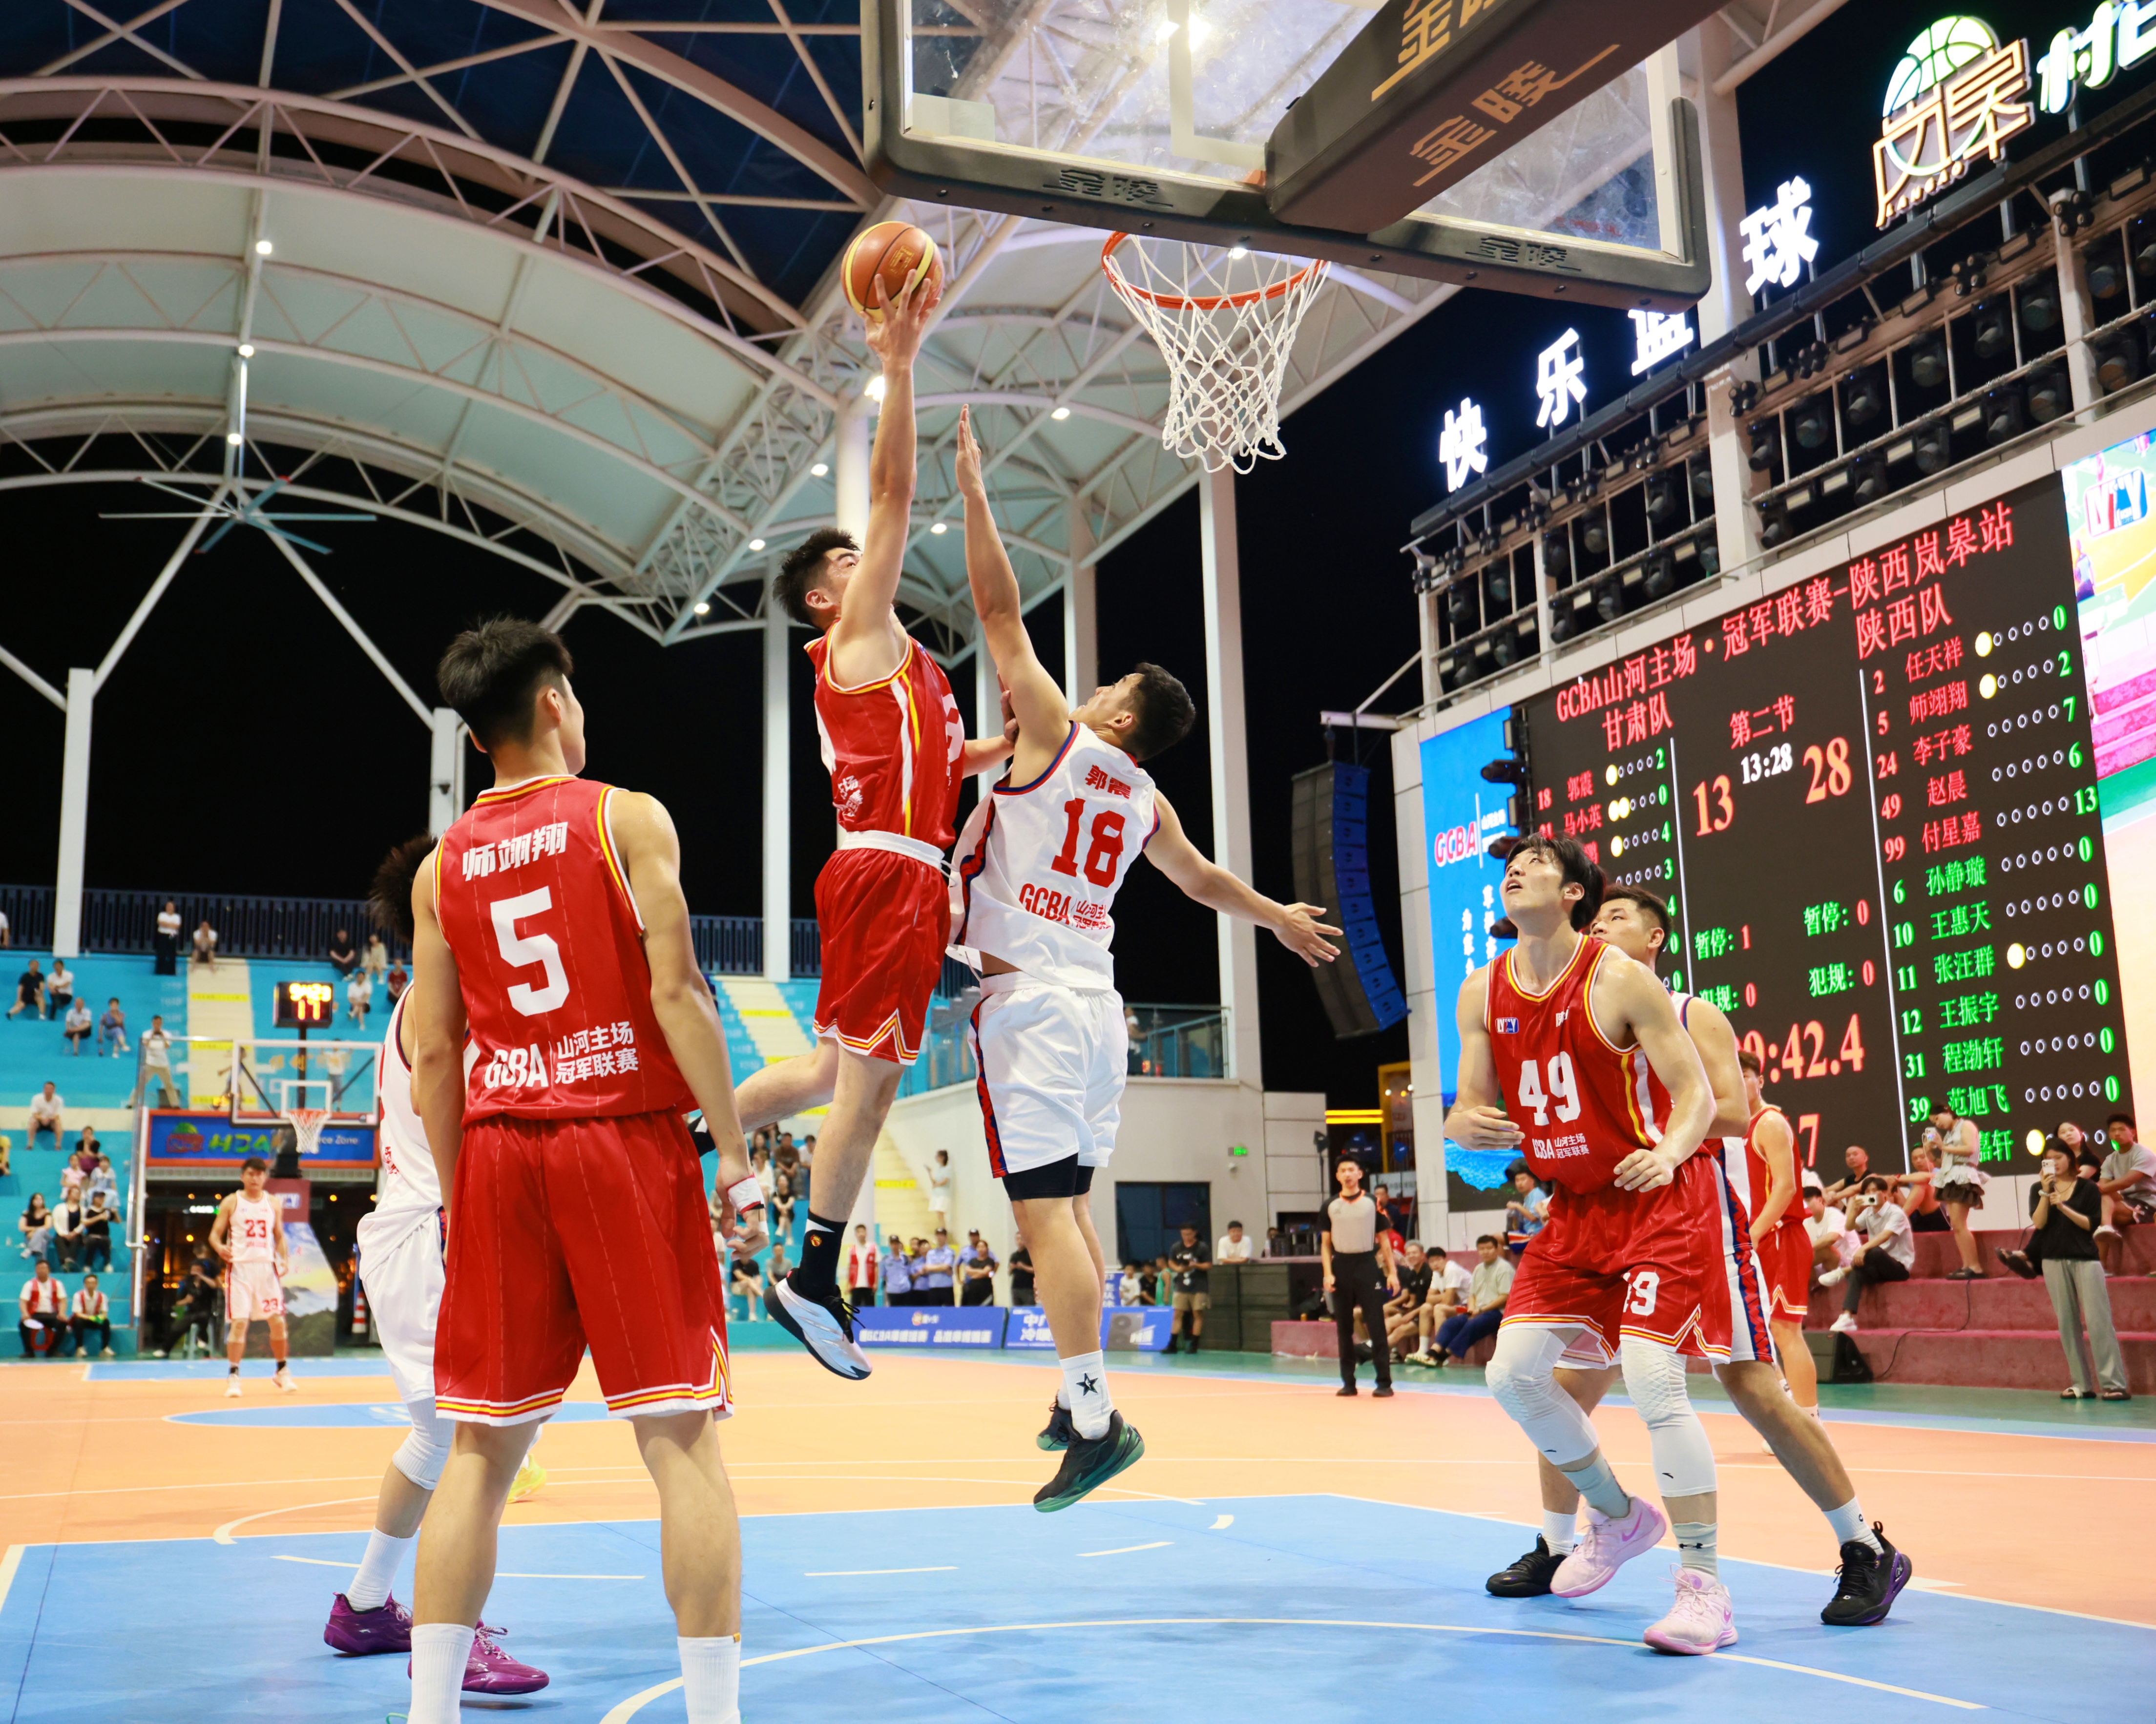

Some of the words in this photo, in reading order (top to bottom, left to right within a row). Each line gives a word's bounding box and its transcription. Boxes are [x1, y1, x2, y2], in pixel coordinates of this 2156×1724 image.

[1371, 0, 1495, 102] 金
[1409, 44, 1620, 187] 金陵
[1856, 583, 1952, 660] 陕西队
[1873, 670, 1885, 694] 2
[1905, 636, 1963, 683] 任天祥
[2052, 605, 2067, 630] 0
[1878, 711, 1889, 735] 5
[1909, 681, 1968, 726] 师翊翔
[2057, 650, 2072, 677] 2
[1602, 691, 1674, 752] 甘肃队
[1730, 695, 1795, 749] 第二节
[1877, 751, 1898, 779] 24
[1913, 724, 1973, 767] 李子豪
[2063, 696, 2076, 723] 7
[1085, 764, 1131, 800] 郭震
[1538, 788, 1552, 810] 18
[1567, 770, 1594, 802] 郭震
[1655, 747, 1666, 770] 2
[1740, 743, 1793, 784] 13:28
[1803, 737, 1852, 805] 28
[1881, 793, 1902, 820] 49
[1927, 770, 1968, 807] 赵晨
[2069, 742, 2082, 769] 6
[1564, 804, 1603, 838] 马小英
[1658, 783, 1669, 806] 0
[1661, 820, 1671, 843] 4
[1693, 775, 1735, 836] 13
[1884, 835, 1906, 863] 99
[1922, 811, 1982, 853] 付星嘉
[2073, 786, 2099, 815] 13
[462, 822, 568, 881] 师翊翔
[1051, 798, 1126, 889] 18
[1435, 821, 1479, 867] GCBA
[1664, 857, 1674, 880] 3
[1893, 879, 1906, 904] 6
[2078, 835, 2093, 863] 0
[1019, 883, 1072, 925] GCBA
[1667, 894, 1677, 916] 4
[1857, 899, 1869, 926] 0
[1893, 921, 1915, 948] 10
[1930, 900, 1992, 940] 王惠天
[2084, 883, 2099, 910] 0
[490, 885, 570, 1017] 5
[1670, 932, 1680, 955] 0
[1741, 925, 1751, 950] 1
[1897, 965, 1918, 991] 11
[1933, 945, 1996, 985] 张汪群
[2089, 930, 2104, 957] 0
[1673, 970, 1683, 993] 0
[1745, 982, 1757, 1008] 0
[1862, 960, 1875, 987] 0
[1901, 1009, 1923, 1035] 12
[1939, 991, 2000, 1029] 王振宇
[2094, 978, 2109, 1005] 0
[555, 1048, 639, 1085] 冠军联赛
[557, 1021, 634, 1059] 山河主场
[1905, 1053, 1926, 1079] 31
[2099, 1027, 2114, 1054] 0
[1518, 1050, 1581, 1126] 49
[1908, 1097, 1931, 1122] 39
[1947, 1084, 2011, 1117] 范旭飞
[2105, 1075, 2120, 1102] 0
[1554, 1133, 1586, 1147] 山河主场
[1555, 1144, 1590, 1159] 冠军联赛
[246, 1219, 267, 1238] 23
[262, 1298, 278, 1313] 23
